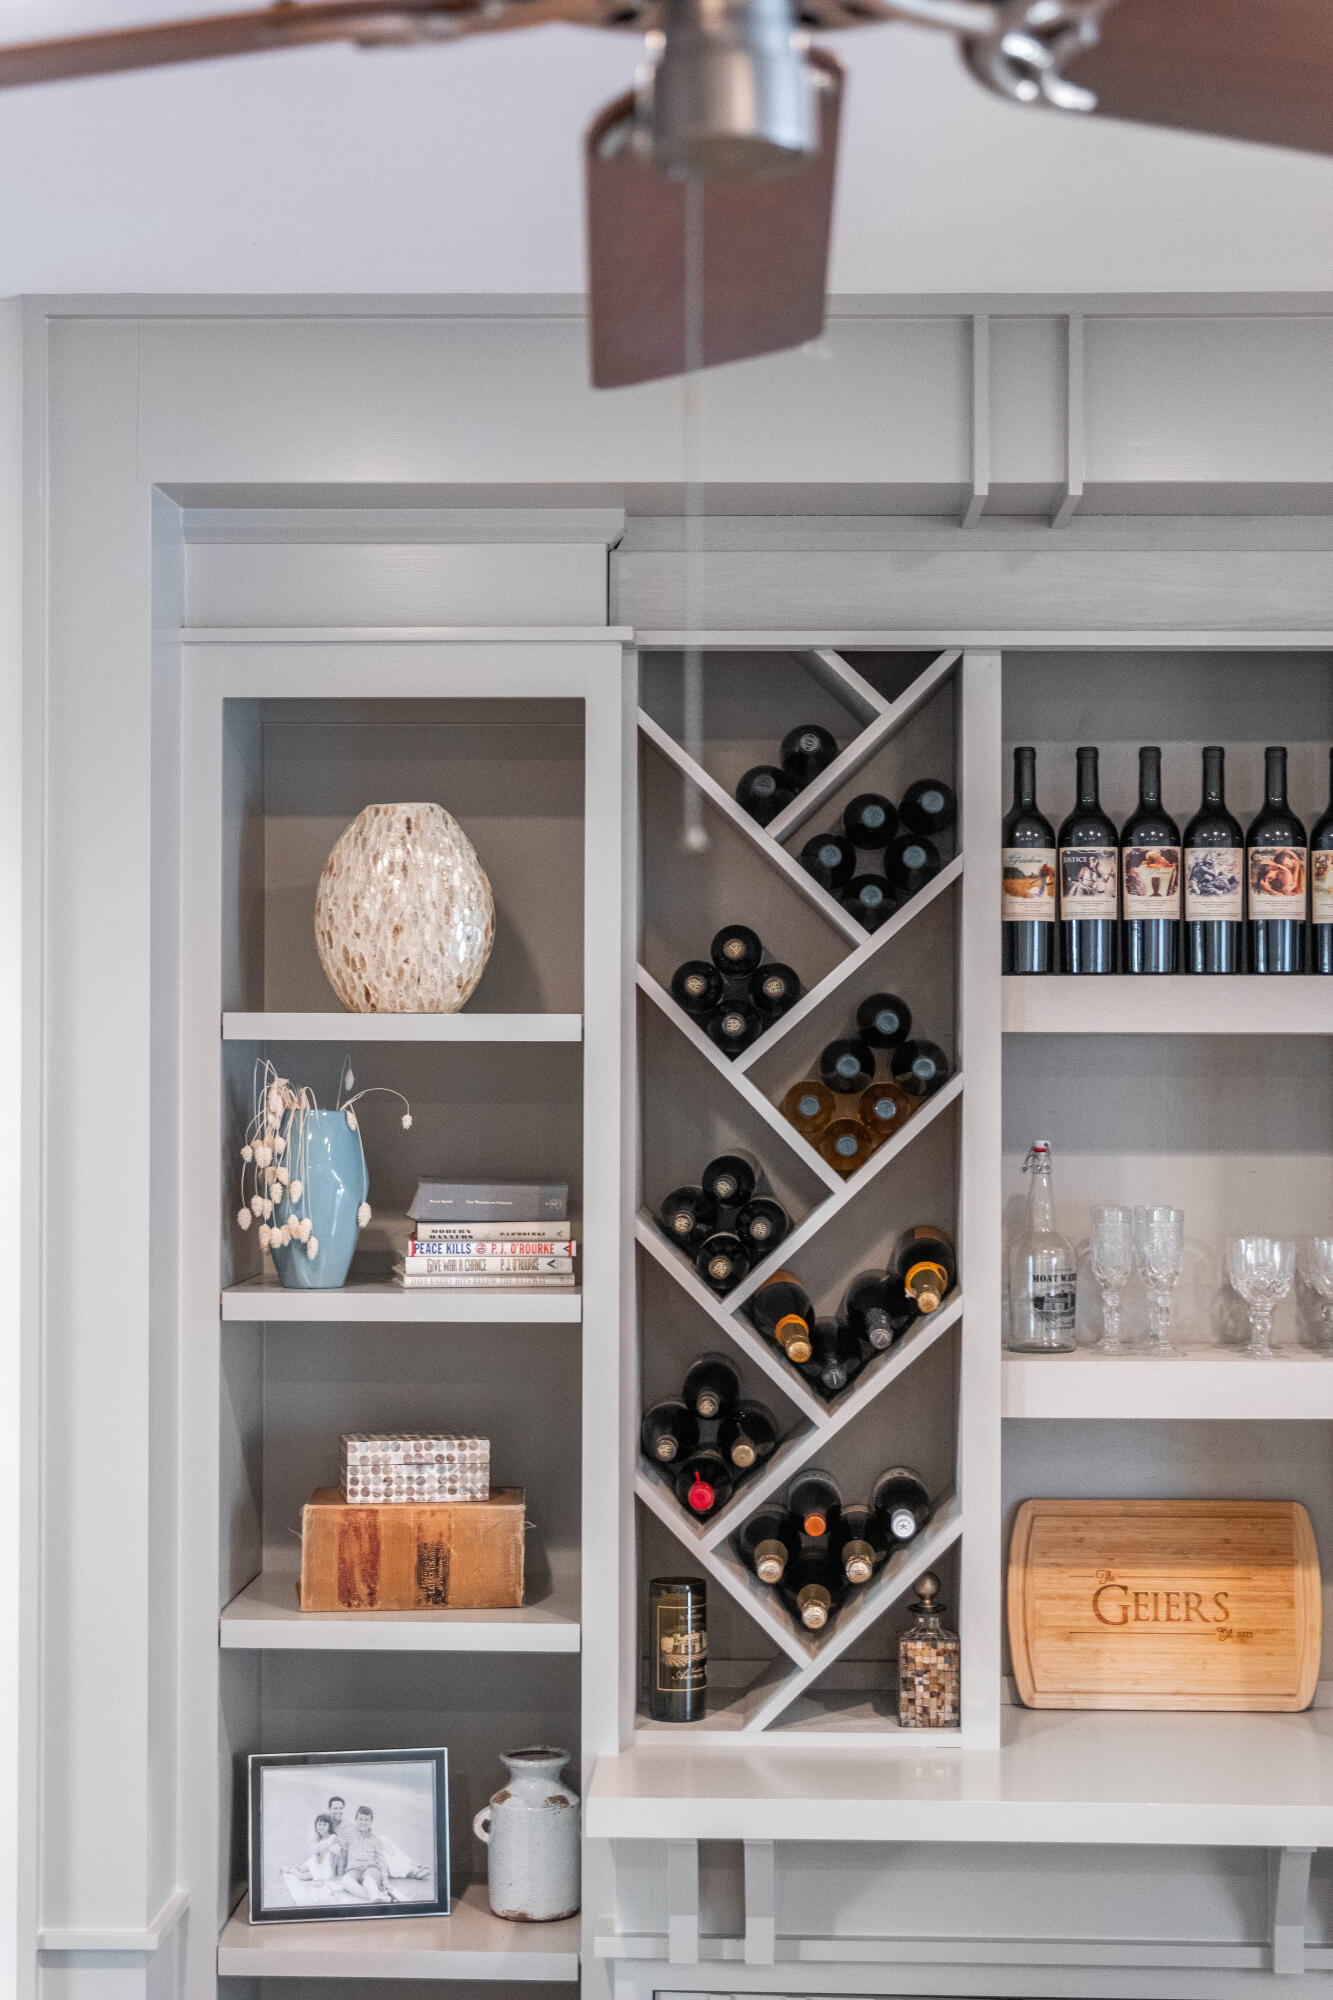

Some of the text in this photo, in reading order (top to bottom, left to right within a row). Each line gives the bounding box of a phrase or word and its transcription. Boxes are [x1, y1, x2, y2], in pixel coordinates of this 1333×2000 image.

[414, 1243, 442, 1254] PEACE
[446, 1243, 471, 1254] KILLS
[511, 1243, 555, 1254] O'ROURKE
[427, 1259, 442, 1273] GIVE
[443, 1259, 457, 1272] WAR
[464, 1259, 488, 1272] CHANCE
[1032, 1274, 1057, 1283] MOAT
[1095, 1570, 1116, 1584] The
[1092, 1584, 1230, 1626] GEIERS
